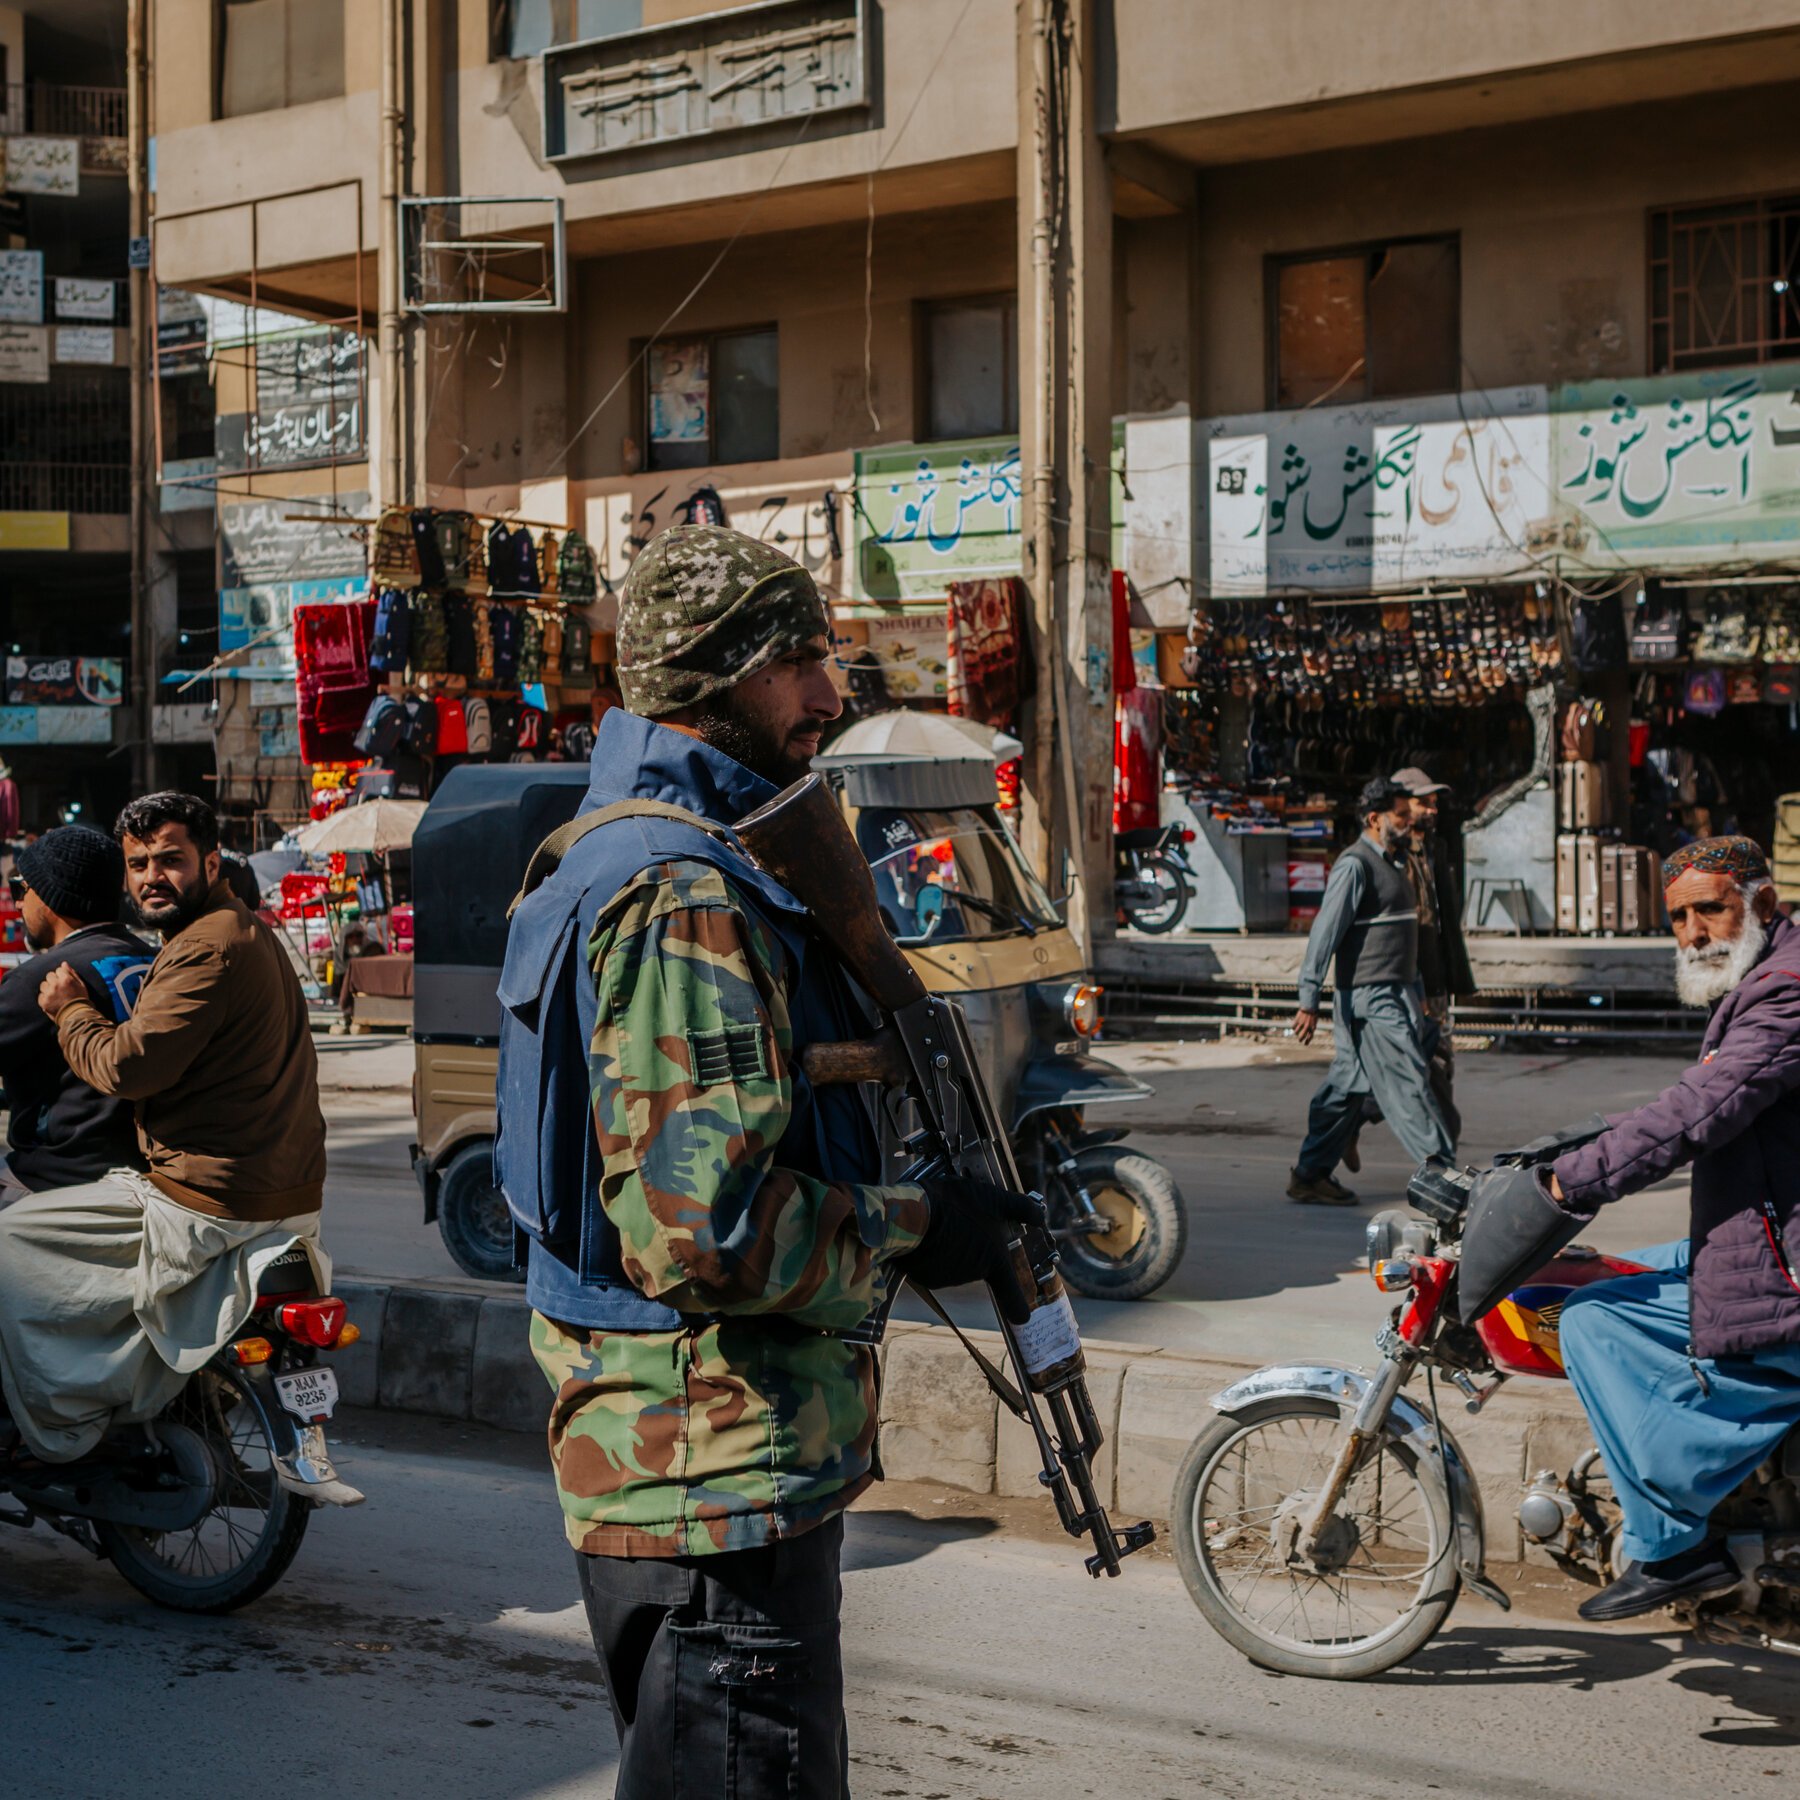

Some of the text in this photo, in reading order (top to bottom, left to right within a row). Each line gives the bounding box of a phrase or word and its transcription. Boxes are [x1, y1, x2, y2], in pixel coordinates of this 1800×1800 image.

[1218, 469, 1244, 491] 89
[1243, 443, 1312, 539] شوز
[1303, 424, 1423, 541] انگلش
[1563, 393, 1649, 505] شوز
[1620, 376, 1764, 519] انگلش
[294, 1389, 327, 1408] 9235
